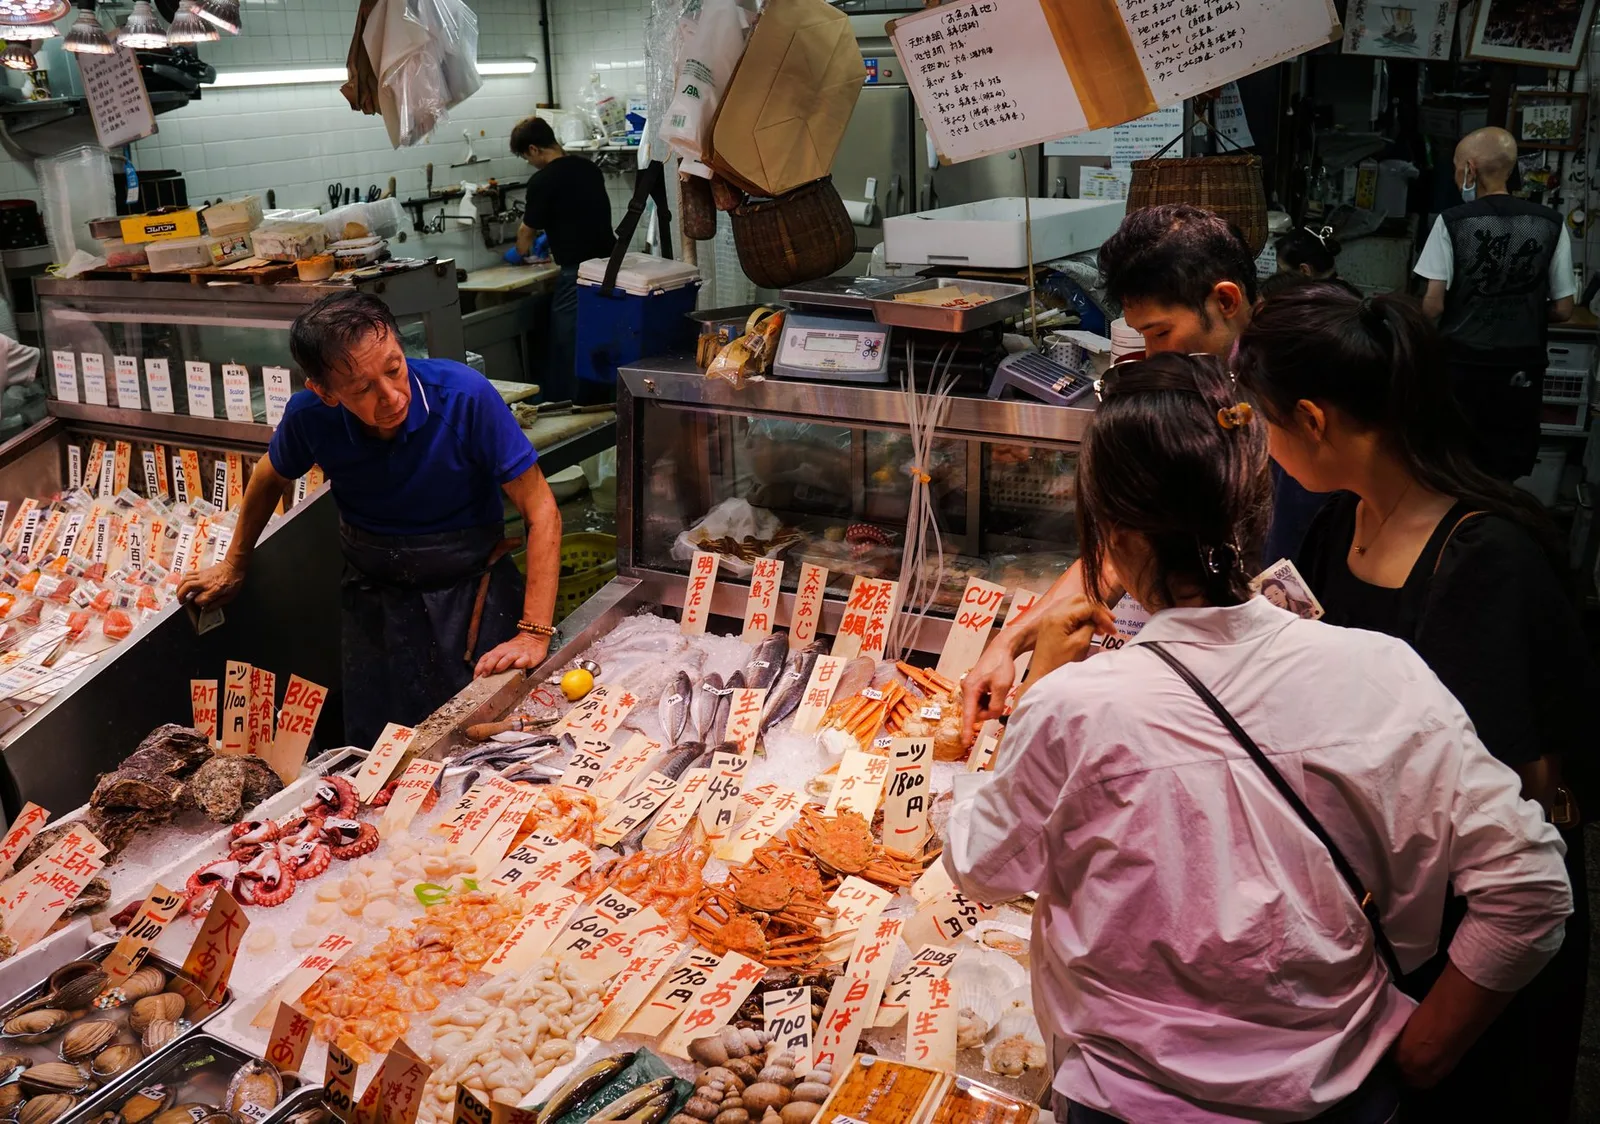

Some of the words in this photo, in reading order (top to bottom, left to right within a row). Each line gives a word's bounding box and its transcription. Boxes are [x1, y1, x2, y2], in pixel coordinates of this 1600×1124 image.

[271, 375, 282, 384] タコ
[95, 523, 105, 561] 四百五十
[190, 519, 208, 570] 大とろ
[1273, 565, 1292, 580] 5000
[686, 555, 714, 624] 明石たこ
[794, 567, 822, 640] 天然あじ
[964, 586, 1004, 612] CUT
[861, 582, 893, 652] 天然本鯛
[229, 665, 247, 681] 一ツ
[803, 661, 839, 708] 甘鯛
[192, 684, 217, 704] EAT
[284, 682, 322, 716] BIG
[194, 708, 216, 723] HERE
[259, 672, 273, 743] 生食用
[234, 716, 244, 733] 円
[279, 711, 314, 736] SIZE
[368, 727, 413, 777] 新たこ
[584, 740, 611, 753] 一ツ
[896, 744, 927, 762] 一ツ
[405, 762, 440, 777] EAT
[569, 754, 601, 771] 250
[717, 758, 748, 773] 一ツ
[397, 779, 433, 792] HERE
[575, 775, 594, 788] 円
[648, 778, 676, 790] 一ツ
[706, 776, 740, 804] 450
[888, 772, 925, 797] 1800
[622, 791, 655, 810] 150
[906, 796, 923, 818] 円
[614, 815, 636, 829] 円
[716, 809, 732, 826] 円
[531, 832, 559, 847] 一ツ
[62, 851, 98, 877] EAT
[507, 847, 538, 865] 200
[501, 866, 522, 883] 円
[46, 872, 81, 900] HERE
[151, 896, 180, 911] 一ツ
[597, 893, 638, 919] 100g
[837, 886, 881, 908] CUT
[126, 915, 162, 941] 1100
[570, 915, 609, 938] 600
[319, 934, 353, 951] EAT
[567, 938, 592, 951] 円
[297, 955, 333, 971] HERE
[690, 955, 720, 967] 一ツ
[911, 947, 956, 967] 100g
[666, 988, 693, 1003] 円
[769, 1015, 806, 1043] 700
